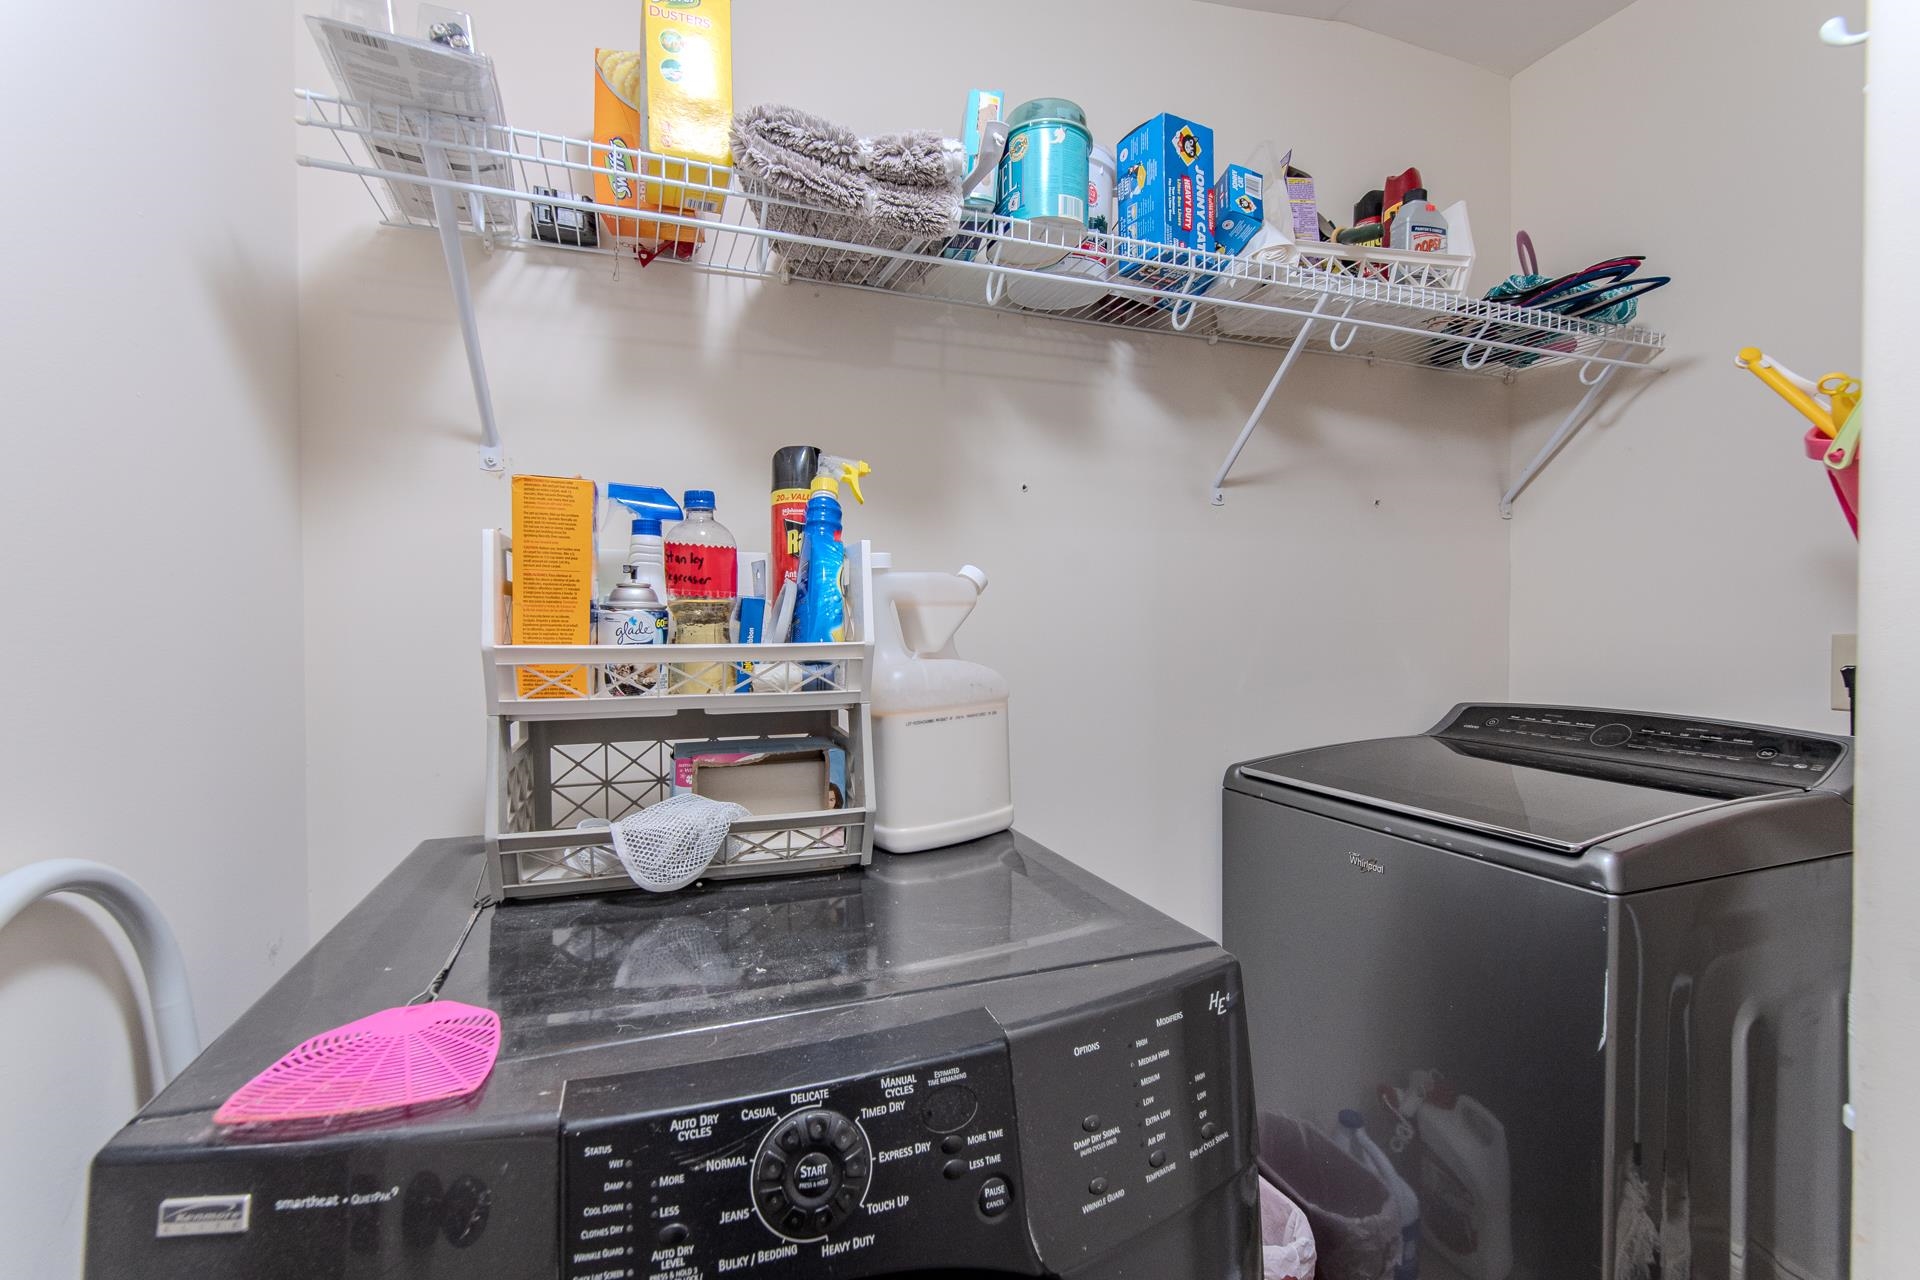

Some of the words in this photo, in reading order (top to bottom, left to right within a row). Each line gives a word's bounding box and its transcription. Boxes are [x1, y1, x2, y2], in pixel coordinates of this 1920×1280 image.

[650, 5, 710, 29] DUSTERS
[1184, 178, 1192, 206] HEAVY
[1195, 165, 1206, 220] JONNY
[1184, 207, 1192, 229] DUTY
[1196, 222, 1206, 250] CAT
[656, 618, 665, 628] 60
[616, 621, 654, 646] glade
[1350, 854, 1384, 874] Whirlpool
[1156, 1011, 1184, 1027] MODIFIERS
[1074, 1041, 1100, 1057] OPTIONS
[1136, 1038, 1148, 1048] HIGH
[1138, 1054, 1158, 1067] MEDIUM
[1158, 1049, 1170, 1060] HIGH
[934, 1067, 960, 1078] ESTIMATED
[1140, 1073, 1160, 1086] MEDIUM
[881, 1074, 917, 1088] MANUAL
[928, 1078, 939, 1087] TIME
[790, 1088, 829, 1104] DELICATE
[885, 1084, 914, 1098] CYCLES
[1197, 1090, 1206, 1100] LOW
[1142, 1096, 1154, 1106] LOW
[741, 1106, 777, 1121] CASUAL
[861, 1104, 887, 1119] TIMED
[889, 1100, 906, 1113] DRY
[1145, 1115, 1159, 1126] EXTRA
[1160, 1108, 1171, 1120] LOW
[1199, 1110, 1208, 1120] OFF
[670, 1119, 697, 1132] AUTO
[700, 1114, 719, 1126] DRY
[678, 1126, 712, 1142] CYCLES
[967, 1133, 987, 1146] MORE
[988, 1128, 1004, 1140] TIME
[1074, 1137, 1091, 1150] DAMP
[1091, 1133, 1102, 1144] DRY
[1102, 1126, 1120, 1139] SIGNAL
[1148, 1138, 1157, 1146] AIR
[1157, 1132, 1166, 1142] DRY
[585, 1145, 612, 1157] STATUS
[879, 1145, 913, 1163] EXPRESS
[915, 1141, 932, 1154] DRY
[609, 1160, 624, 1169] WET
[706, 1156, 747, 1172] NORMAL
[969, 1158, 985, 1170] LESS
[986, 1154, 1001, 1166] TIME
[800, 1163, 828, 1179] START
[1145, 1162, 1176, 1184] TEMPERATURE
[604, 1182, 624, 1192] DAMP
[659, 1174, 684, 1187] MORE
[984, 1185, 1006, 1198] PAUSE
[275, 1194, 340, 1211] smartheat
[866, 1199, 895, 1216] TOUCH
[897, 1195, 910, 1208] UP
[986, 1199, 1005, 1209] CANCEL
[1082, 1198, 1106, 1214] WRINKLE
[1107, 1188, 1125, 1203] GUARD
[584, 1207, 601, 1217] COOL
[602, 1203, 624, 1214] DOWN
[660, 1205, 680, 1218] LESS
[719, 1208, 750, 1224] JEANS
[581, 1228, 609, 1240] CLOTHES
[610, 1225, 624, 1235] DRY
[651, 1249, 675, 1263] AUTO
[677, 1245, 695, 1257] DRY
[822, 1241, 851, 1258] HEAVY
[853, 1234, 875, 1249] DUTY
[574, 1251, 601, 1263] WRINKLE
[661, 1258, 685, 1270] LEVEL
[718, 1256, 749, 1272] BULKY
[757, 1244, 798, 1263] BEDDING
[676, 1268, 692, 1278] HOLD
